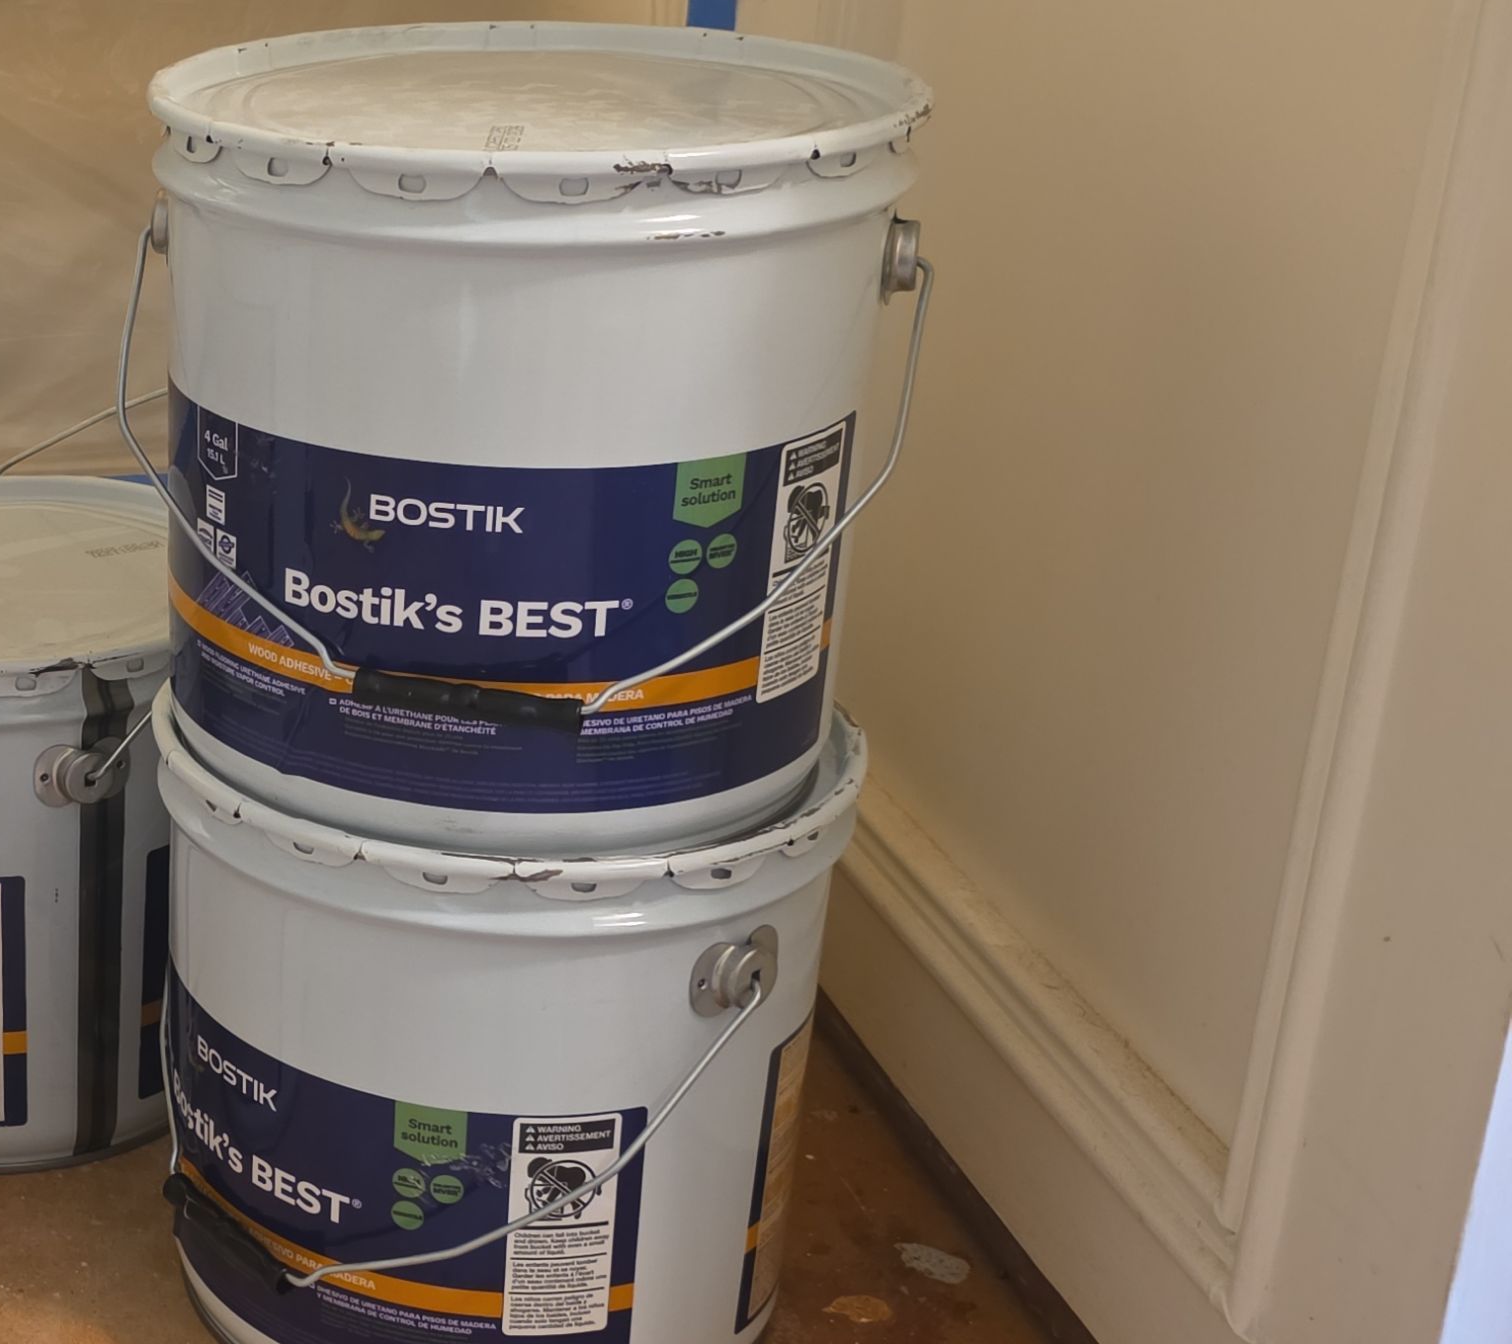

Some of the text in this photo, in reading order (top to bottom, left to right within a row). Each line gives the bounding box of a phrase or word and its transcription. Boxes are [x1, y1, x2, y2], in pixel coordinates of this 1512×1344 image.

[204, 430, 228, 451] 4 Gal
[690, 474, 732, 490] Smart
[681, 489, 736, 507] solution
[370, 494, 525, 534] BOSTIK
[248, 641, 332, 681] WOOD ADHESIVE
[255, 680, 285, 696] CONTROL
[585, 689, 644, 705] MDERA
[352, 709, 370, 718] BOIS
[384, 715, 432, 729] MEMBRANE
[626, 713, 665, 725] URETANO
[667, 710, 688, 718] PARA
[690, 705, 712, 715] PISOS
[580, 726, 631, 735] MEMBRANA
[646, 720, 684, 731] CONTROL
[685, 717, 695, 725] DE
[197, 1035, 277, 1112] BOSTIK
[408, 1118, 452, 1134] Smart
[537, 1125, 581, 1133] WARNING
[401, 1132, 458, 1148] solution
[537, 1130, 611, 1142] AVERTISSEMENT
[379, 1313, 416, 1327] CONTROL
[418, 1321, 429, 1329] DE
[430, 1324, 472, 1335] HUMEDAD
[399, 1311, 420, 1320] PARA
[460, 1320, 497, 1330] MADERA
